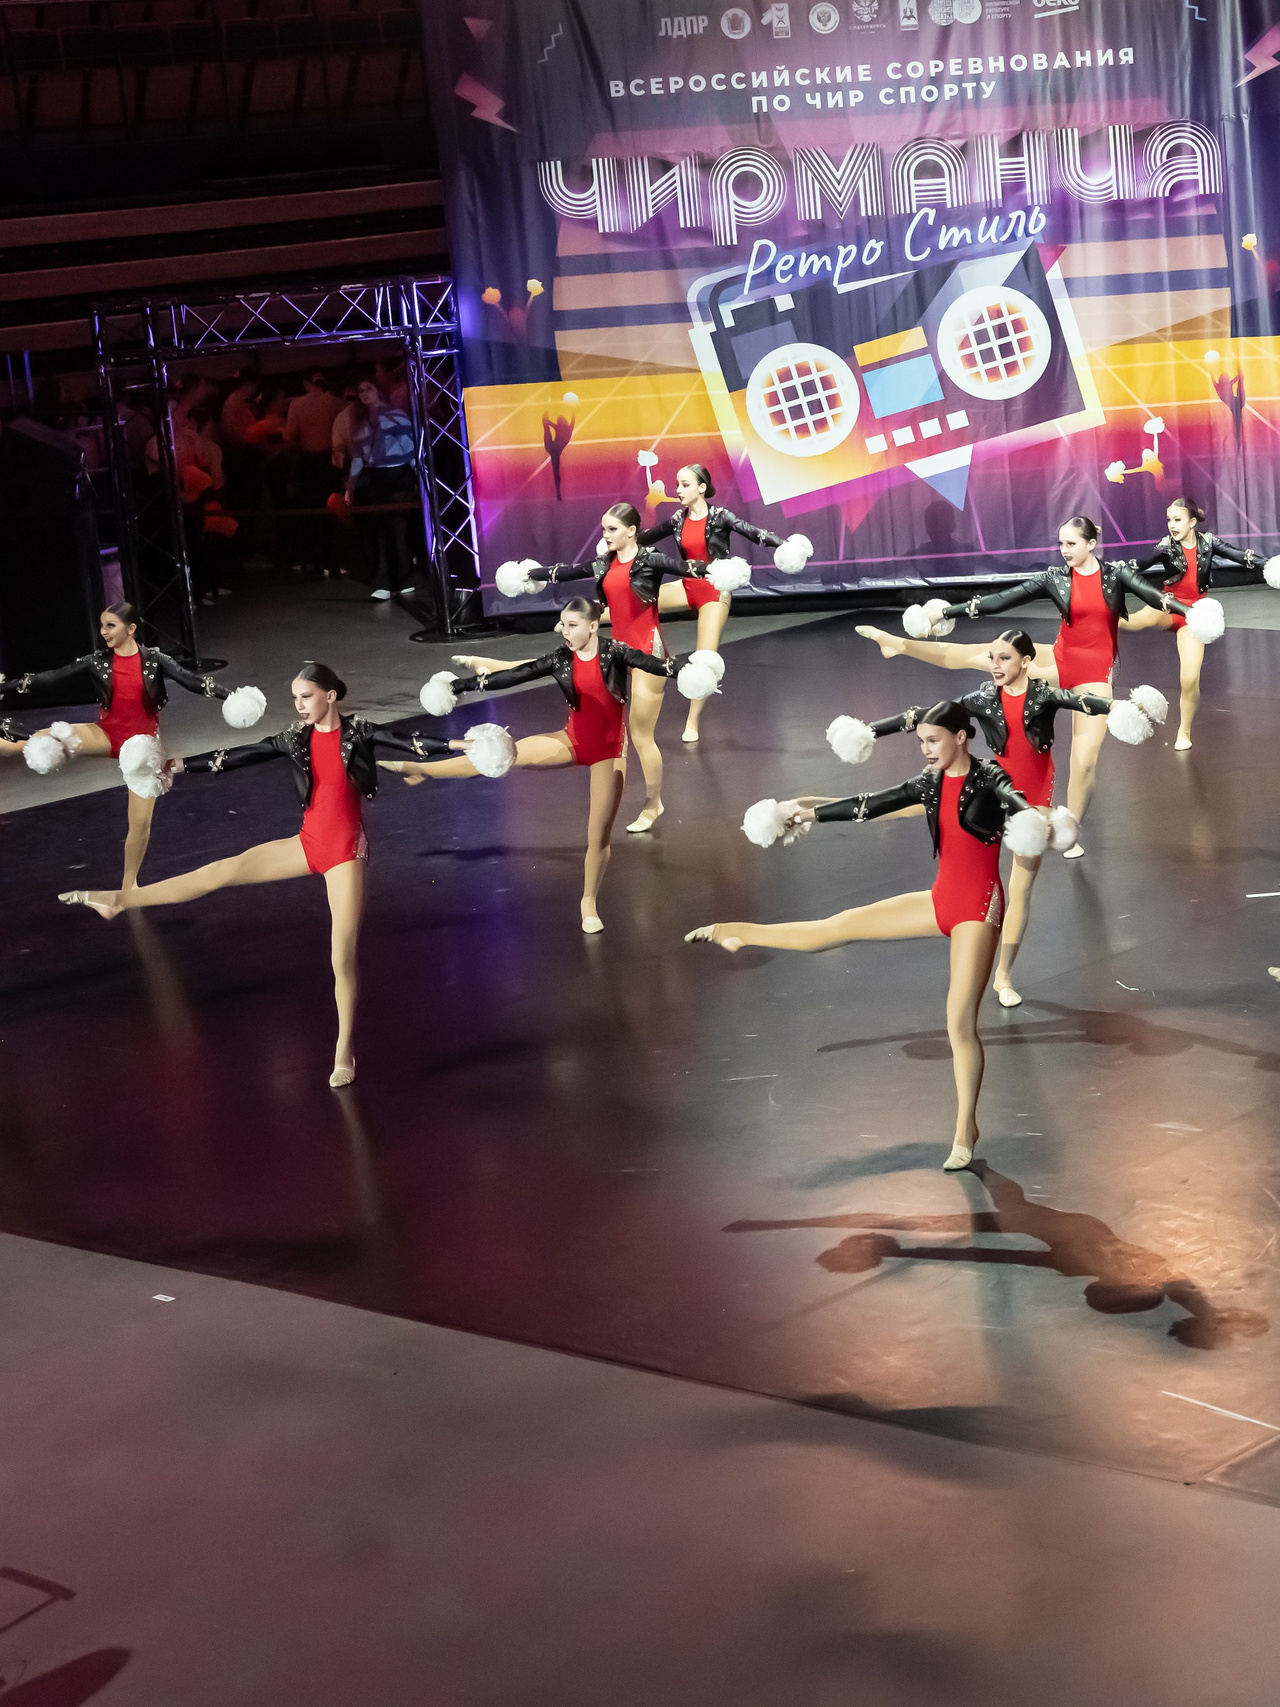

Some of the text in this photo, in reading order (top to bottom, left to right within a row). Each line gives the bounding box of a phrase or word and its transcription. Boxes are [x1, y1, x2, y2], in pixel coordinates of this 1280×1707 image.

[658, 15, 709, 39] ЛДПР
[609, 47, 1135, 97] ВСЕРОССИЙСКИЕ СОРЕВНОВАНИЯ
[751, 80, 997, 113] ПО ЧИР СПОРТУ
[744, 206, 1047, 295] Ретро Стиль
